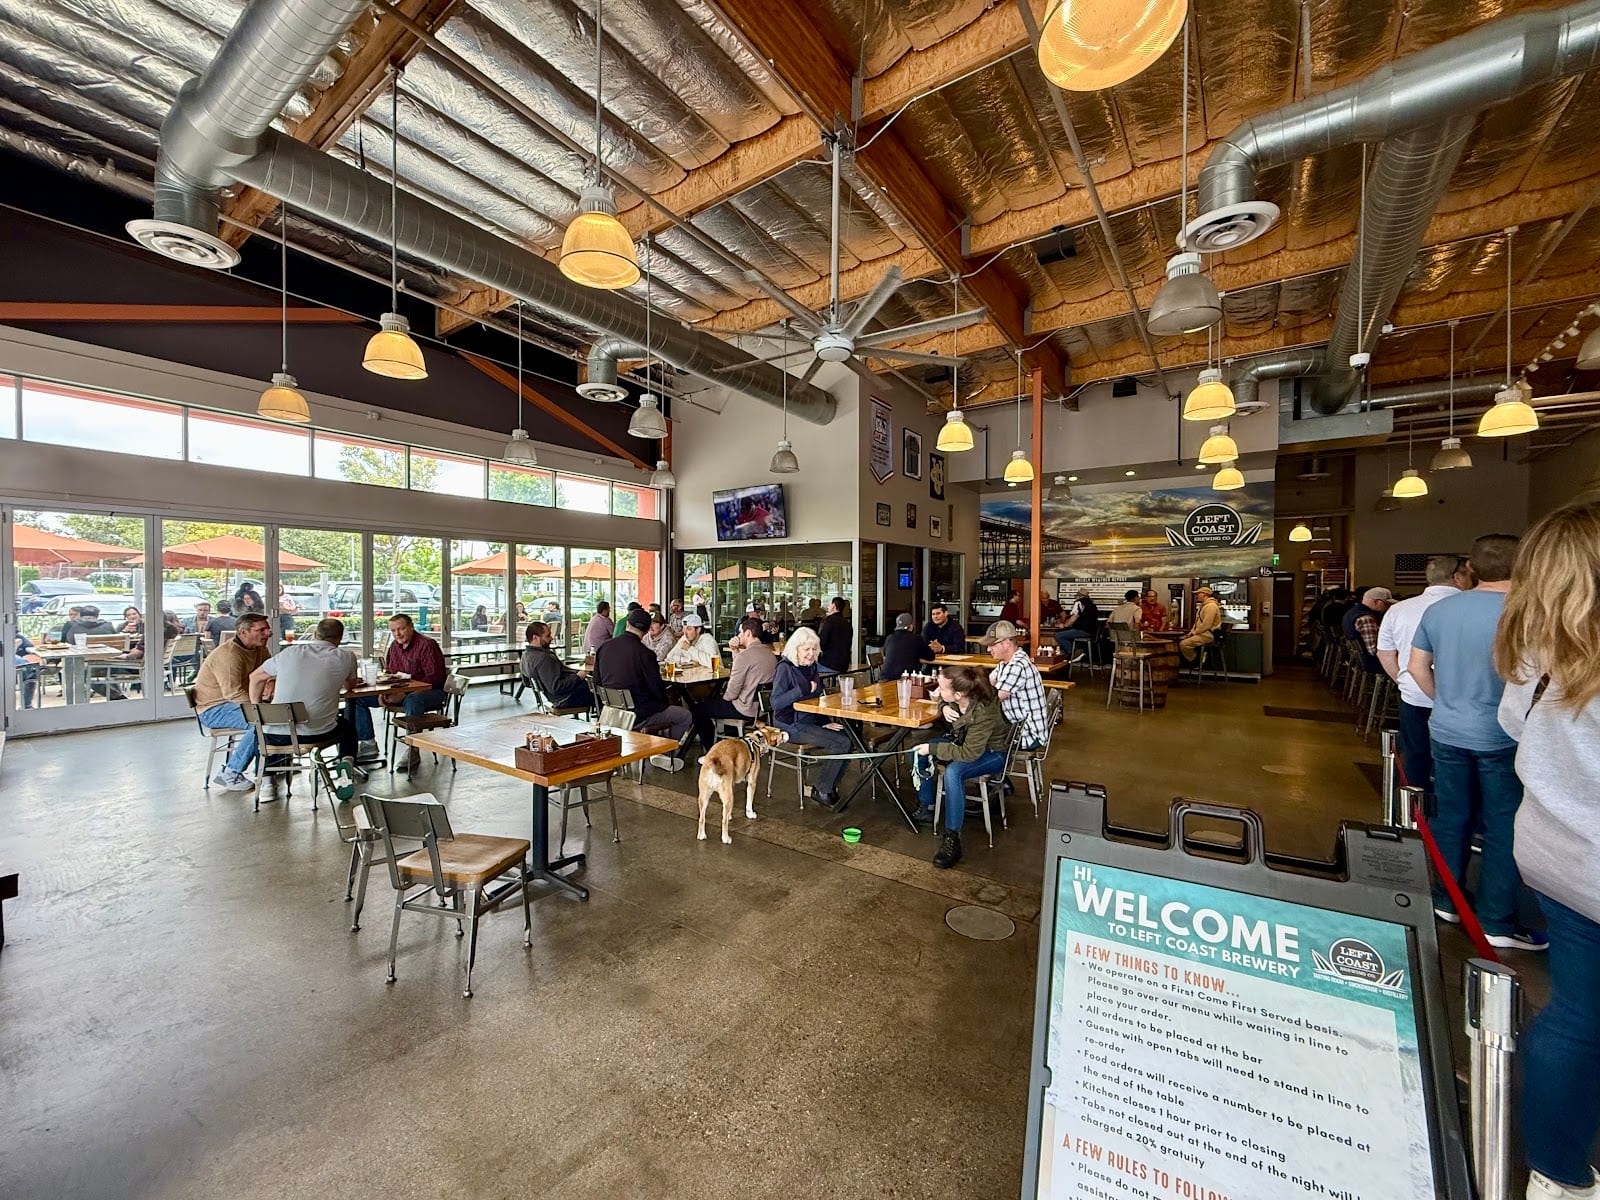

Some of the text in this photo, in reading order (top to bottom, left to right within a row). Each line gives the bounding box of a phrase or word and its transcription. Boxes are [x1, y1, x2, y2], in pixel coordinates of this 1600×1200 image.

[1191, 524, 1234, 534] COAST
[1196, 514, 1230, 524] LEFT
[1074, 866, 1096, 884] HI,
[1073, 880, 1300, 962] WELCOME
[1074, 942, 1081, 955] A
[1086, 945, 1110, 962] FEW
[1115, 952, 1158, 976] THINGS
[1164, 965, 1178, 981] TO
[1108, 922, 1300, 978] TO LEFT COAST BREWERY
[1336, 956, 1378, 972] COAST
[1340, 946, 1372, 960] LEFT
[1340, 966, 1366, 977] BREWING
[1087, 992, 1172, 1022] place your order.
[1088, 976, 1349, 1056] Please go over our menu while waiting in line to
[1089, 962, 1102, 972] We
[1105, 967, 1144, 983] operate
[1171, 984, 1194, 997] First
[1198, 991, 1228, 1006] Come
[1232, 1001, 1256, 1014] First
[1260, 1008, 1301, 1026] Served
[1305, 1019, 1343, 1038] basis.
[1085, 1036, 1126, 1054] re-order
[1086, 1005, 1263, 1064] All orders to be placed at the bar
[1083, 1065, 1184, 1107] the end of the table
[1086, 1020, 1369, 1115] Guests with open tabs will need to stand in line to
[1082, 1080, 1286, 1162] Kitchen closes 1 hour prior to closing
[1084, 1049, 1371, 1153] Food orders will receive a number to be placed at
[1062, 1133, 1070, 1150] A
[1076, 1137, 1102, 1161] FEW
[1108, 1150, 1147, 1180] RULES
[1153, 1168, 1169, 1189] TO
[1081, 1113, 1122, 1135] charged
[1136, 1134, 1157, 1148] 20%
[1160, 1144, 1205, 1168] gratuity
[1082, 1096, 1352, 1200] Tabs not closed out at the end of the night will
[1078, 1162, 1112, 1183] Please
[1115, 1179, 1128, 1190] do
[1132, 1187, 1149, 1198] not
